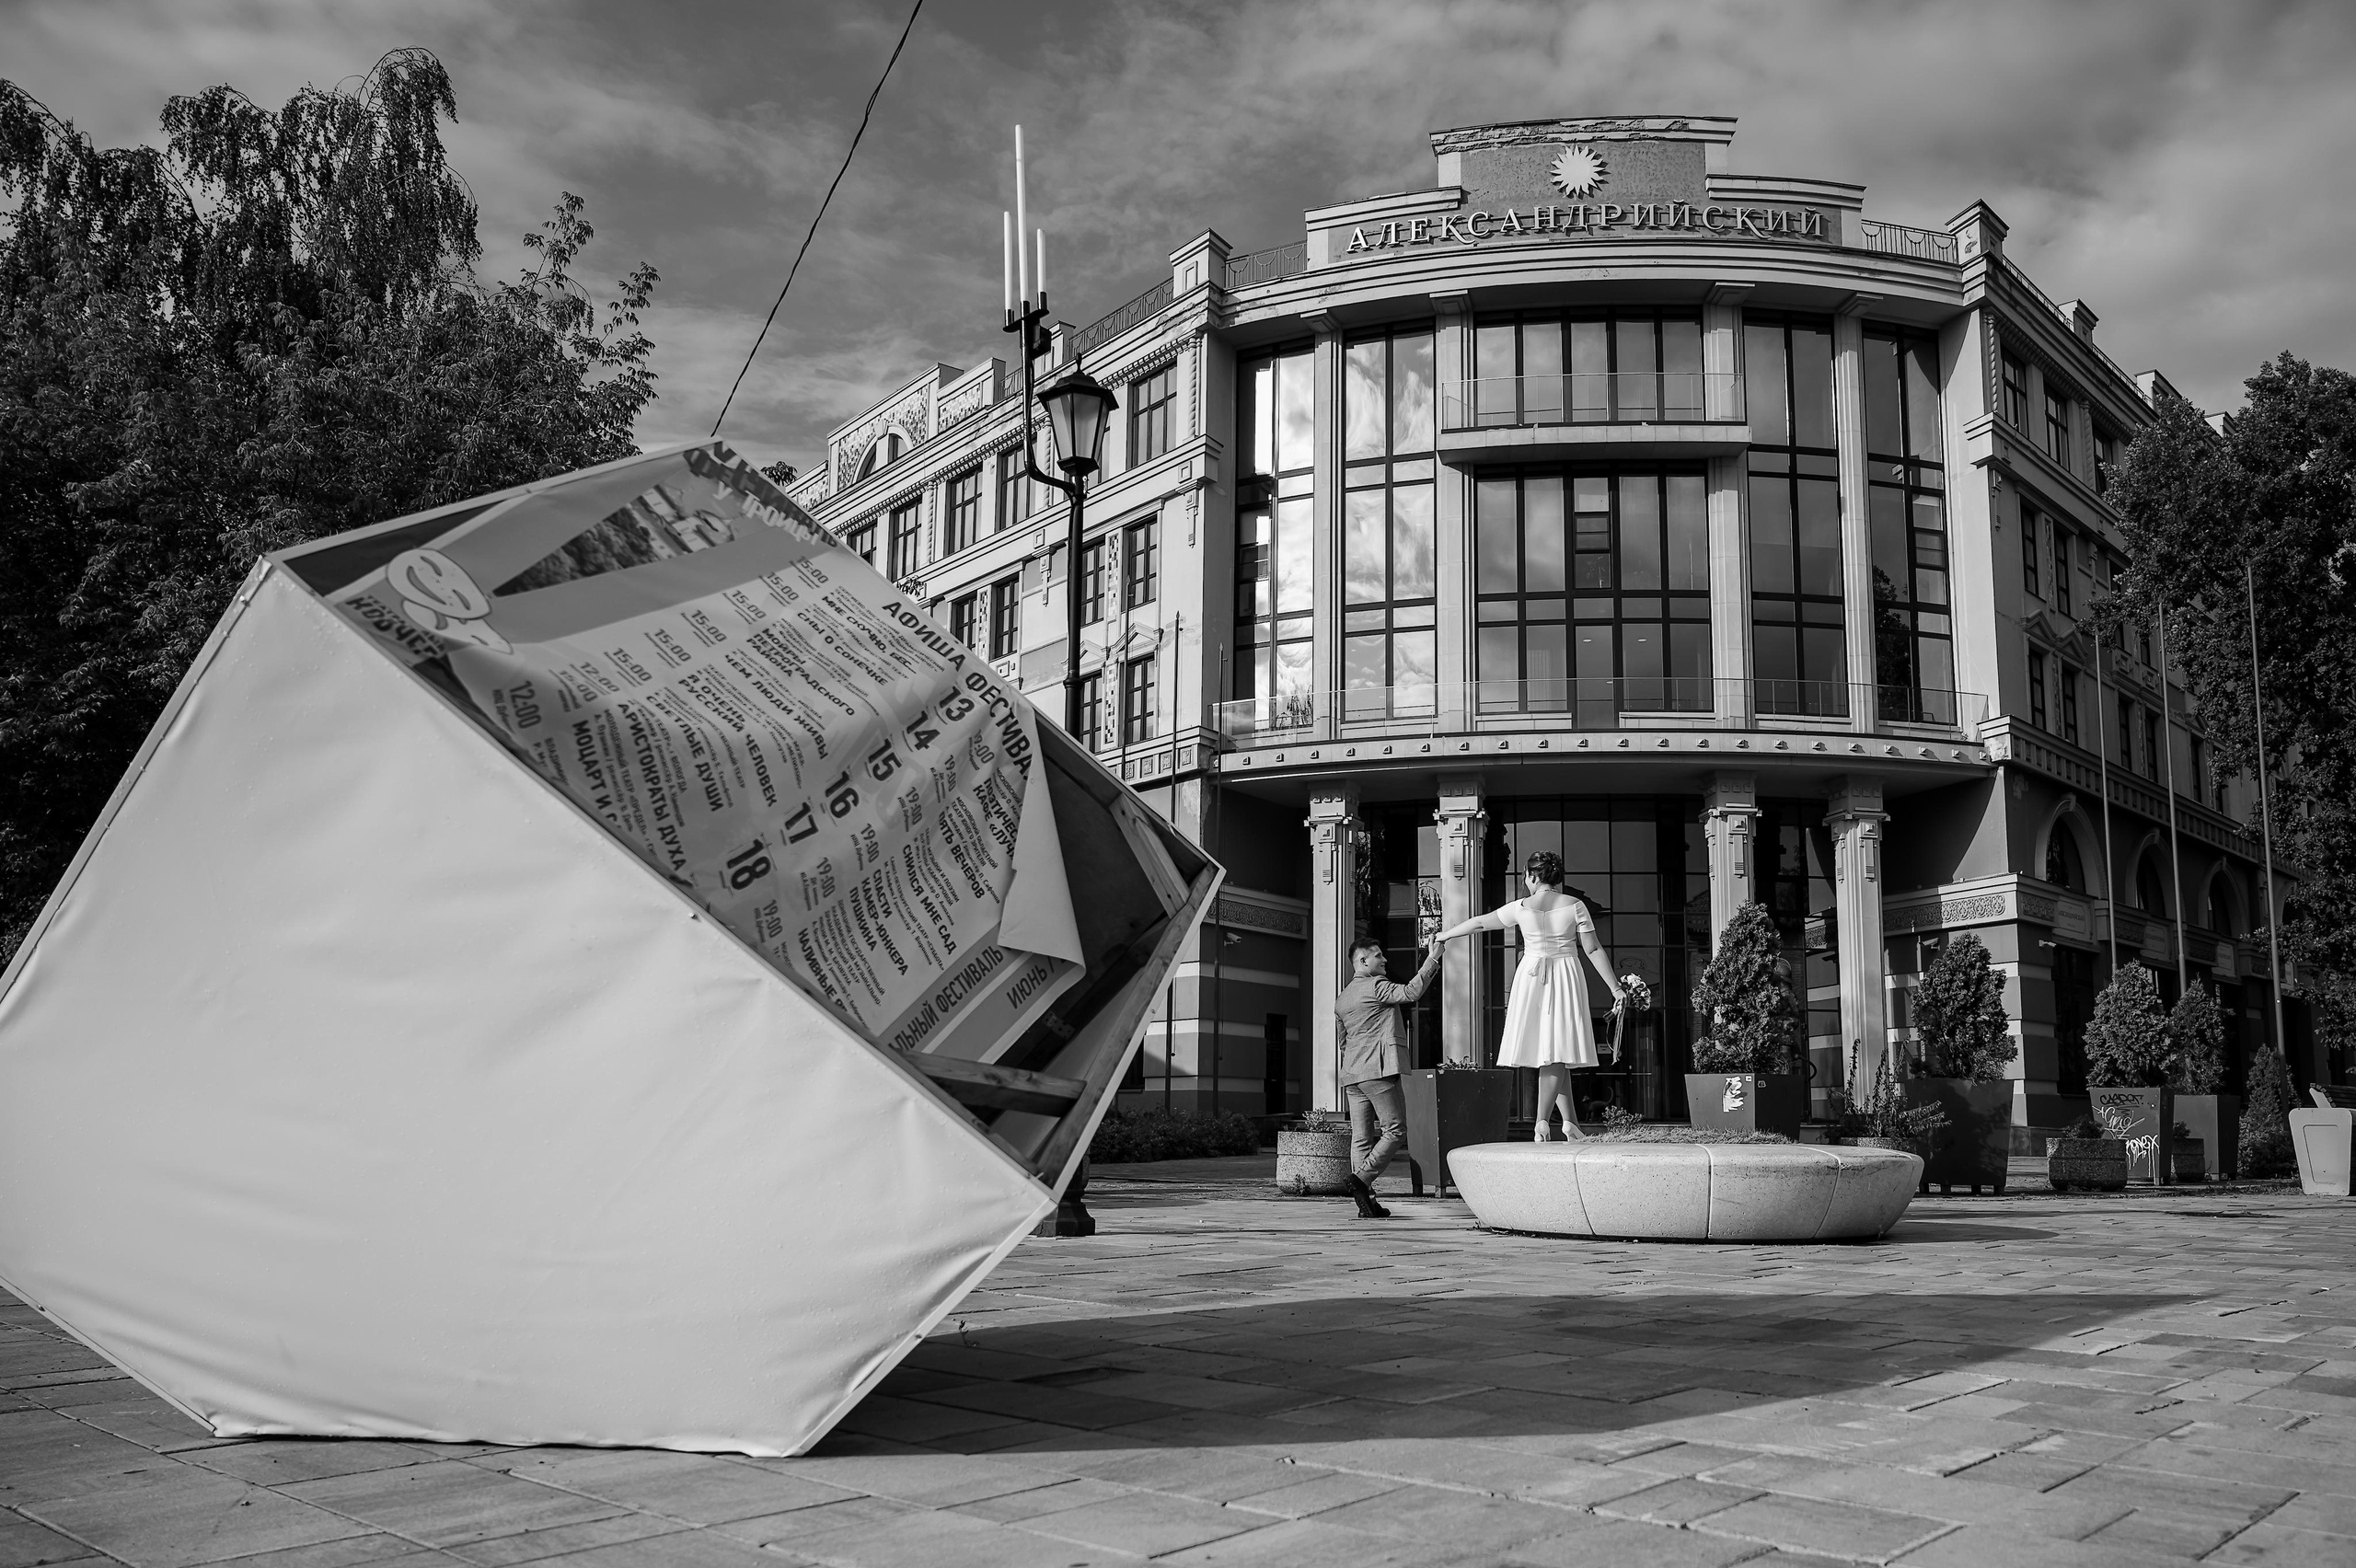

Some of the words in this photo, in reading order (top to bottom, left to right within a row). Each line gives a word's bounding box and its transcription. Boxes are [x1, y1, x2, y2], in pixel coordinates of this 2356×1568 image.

[1345, 199, 1825, 252] АЛЕКСАНДРИЙСКИЙ
[728, 589, 769, 619] 15:00
[763, 571, 802, 601] 15:00
[652, 628, 693, 664] 15:00
[689, 609, 729, 644] 15:00
[759, 627, 808, 665] МОЙРЫ
[820, 595, 848, 617] МНЕ
[845, 615, 891, 654] СКУЧНО,
[610, 647, 654, 684] 15:00
[745, 637, 798, 677] РАЙОНА
[795, 611, 826, 635] СНЫ
[821, 634, 837, 645] О
[832, 644, 890, 686] СОНЕЧКЕ
[578, 661, 622, 695] 12:00
[751, 632, 859, 717] ПЕТРОГРАДСКОГО
[880, 598, 973, 672] АФИША
[964, 672, 1032, 780] ФЕСТИВА
[505, 678, 545, 731] 12:00
[685, 673, 702, 684] Я
[699, 684, 749, 723] ОЧЕНЬ
[721, 653, 755, 679] ЧЕМ
[750, 679, 796, 716] ЛЮДИ
[791, 714, 832, 760] ЖИВЫ
[939, 685, 975, 722] 13
[676, 677, 748, 733] РУССКИЙ
[741, 732, 780, 808] ЧЕЛОВЕК
[906, 709, 941, 751] 14
[570, 718, 608, 793] МОЦАРТ
[592, 792, 616, 810] И
[644, 693, 708, 760] СВЕТЛЫЕ
[693, 759, 726, 813] ДУШИ
[668, 755, 690, 795] ВОЛОГДА
[869, 740, 903, 781] 15
[942, 753, 960, 792] 19:00
[617, 700, 672, 822] АРИСТОКРАТЫ
[655, 822, 691, 872] ДУХА
[619, 768, 638, 794] ТЕАТР
[825, 769, 860, 819] 16
[971, 783, 994, 822] КАФЕ
[784, 802, 819, 844] 17
[903, 785, 927, 826] 19:00
[954, 795, 980, 836] МОСКОВСКИЙ
[858, 822, 882, 864] 19:00
[934, 811, 957, 846] ПЯТЬ
[948, 844, 987, 900] ВЕЧЕРОВ
[949, 801, 964, 820] ТЕАТР
[958, 818, 975, 840] ЮНОГО
[968, 839, 987, 868] ЗРИТЕЛЯ
[727, 837, 772, 891] 18
[814, 856, 838, 899] 19:00
[926, 865, 955, 907] КАМБУРОВОЙ
[870, 868, 895, 919] СПАСТИ
[900, 843, 927, 897] СНИЛСЯ
[918, 894, 944, 925] МНЕ
[935, 924, 960, 956] САД
[941, 877, 961, 904] ПОЭЗИИ
[761, 897, 786, 940] 19:00
[846, 885, 880, 951] ПУШКИНА
[857, 876, 911, 976] КАМЕР-ЮНКЕРА
[914, 921, 930, 940] ТЕАТР
[796, 927, 838, 999] НАЛИВНЫЕ
[845, 963, 861, 985] ТЕАТР
[847, 932, 887, 997] ГОСУДАРСТВЕННЫЙ
[851, 960, 884, 1008] МУЗЫКАЛЬНО-
[886, 998, 941, 1055] ЛЬНЫЙ
[936, 942, 1006, 1014] ФЕСТИВАЛЬ
[1006, 964, 1048, 1009] ИЮНЬ
